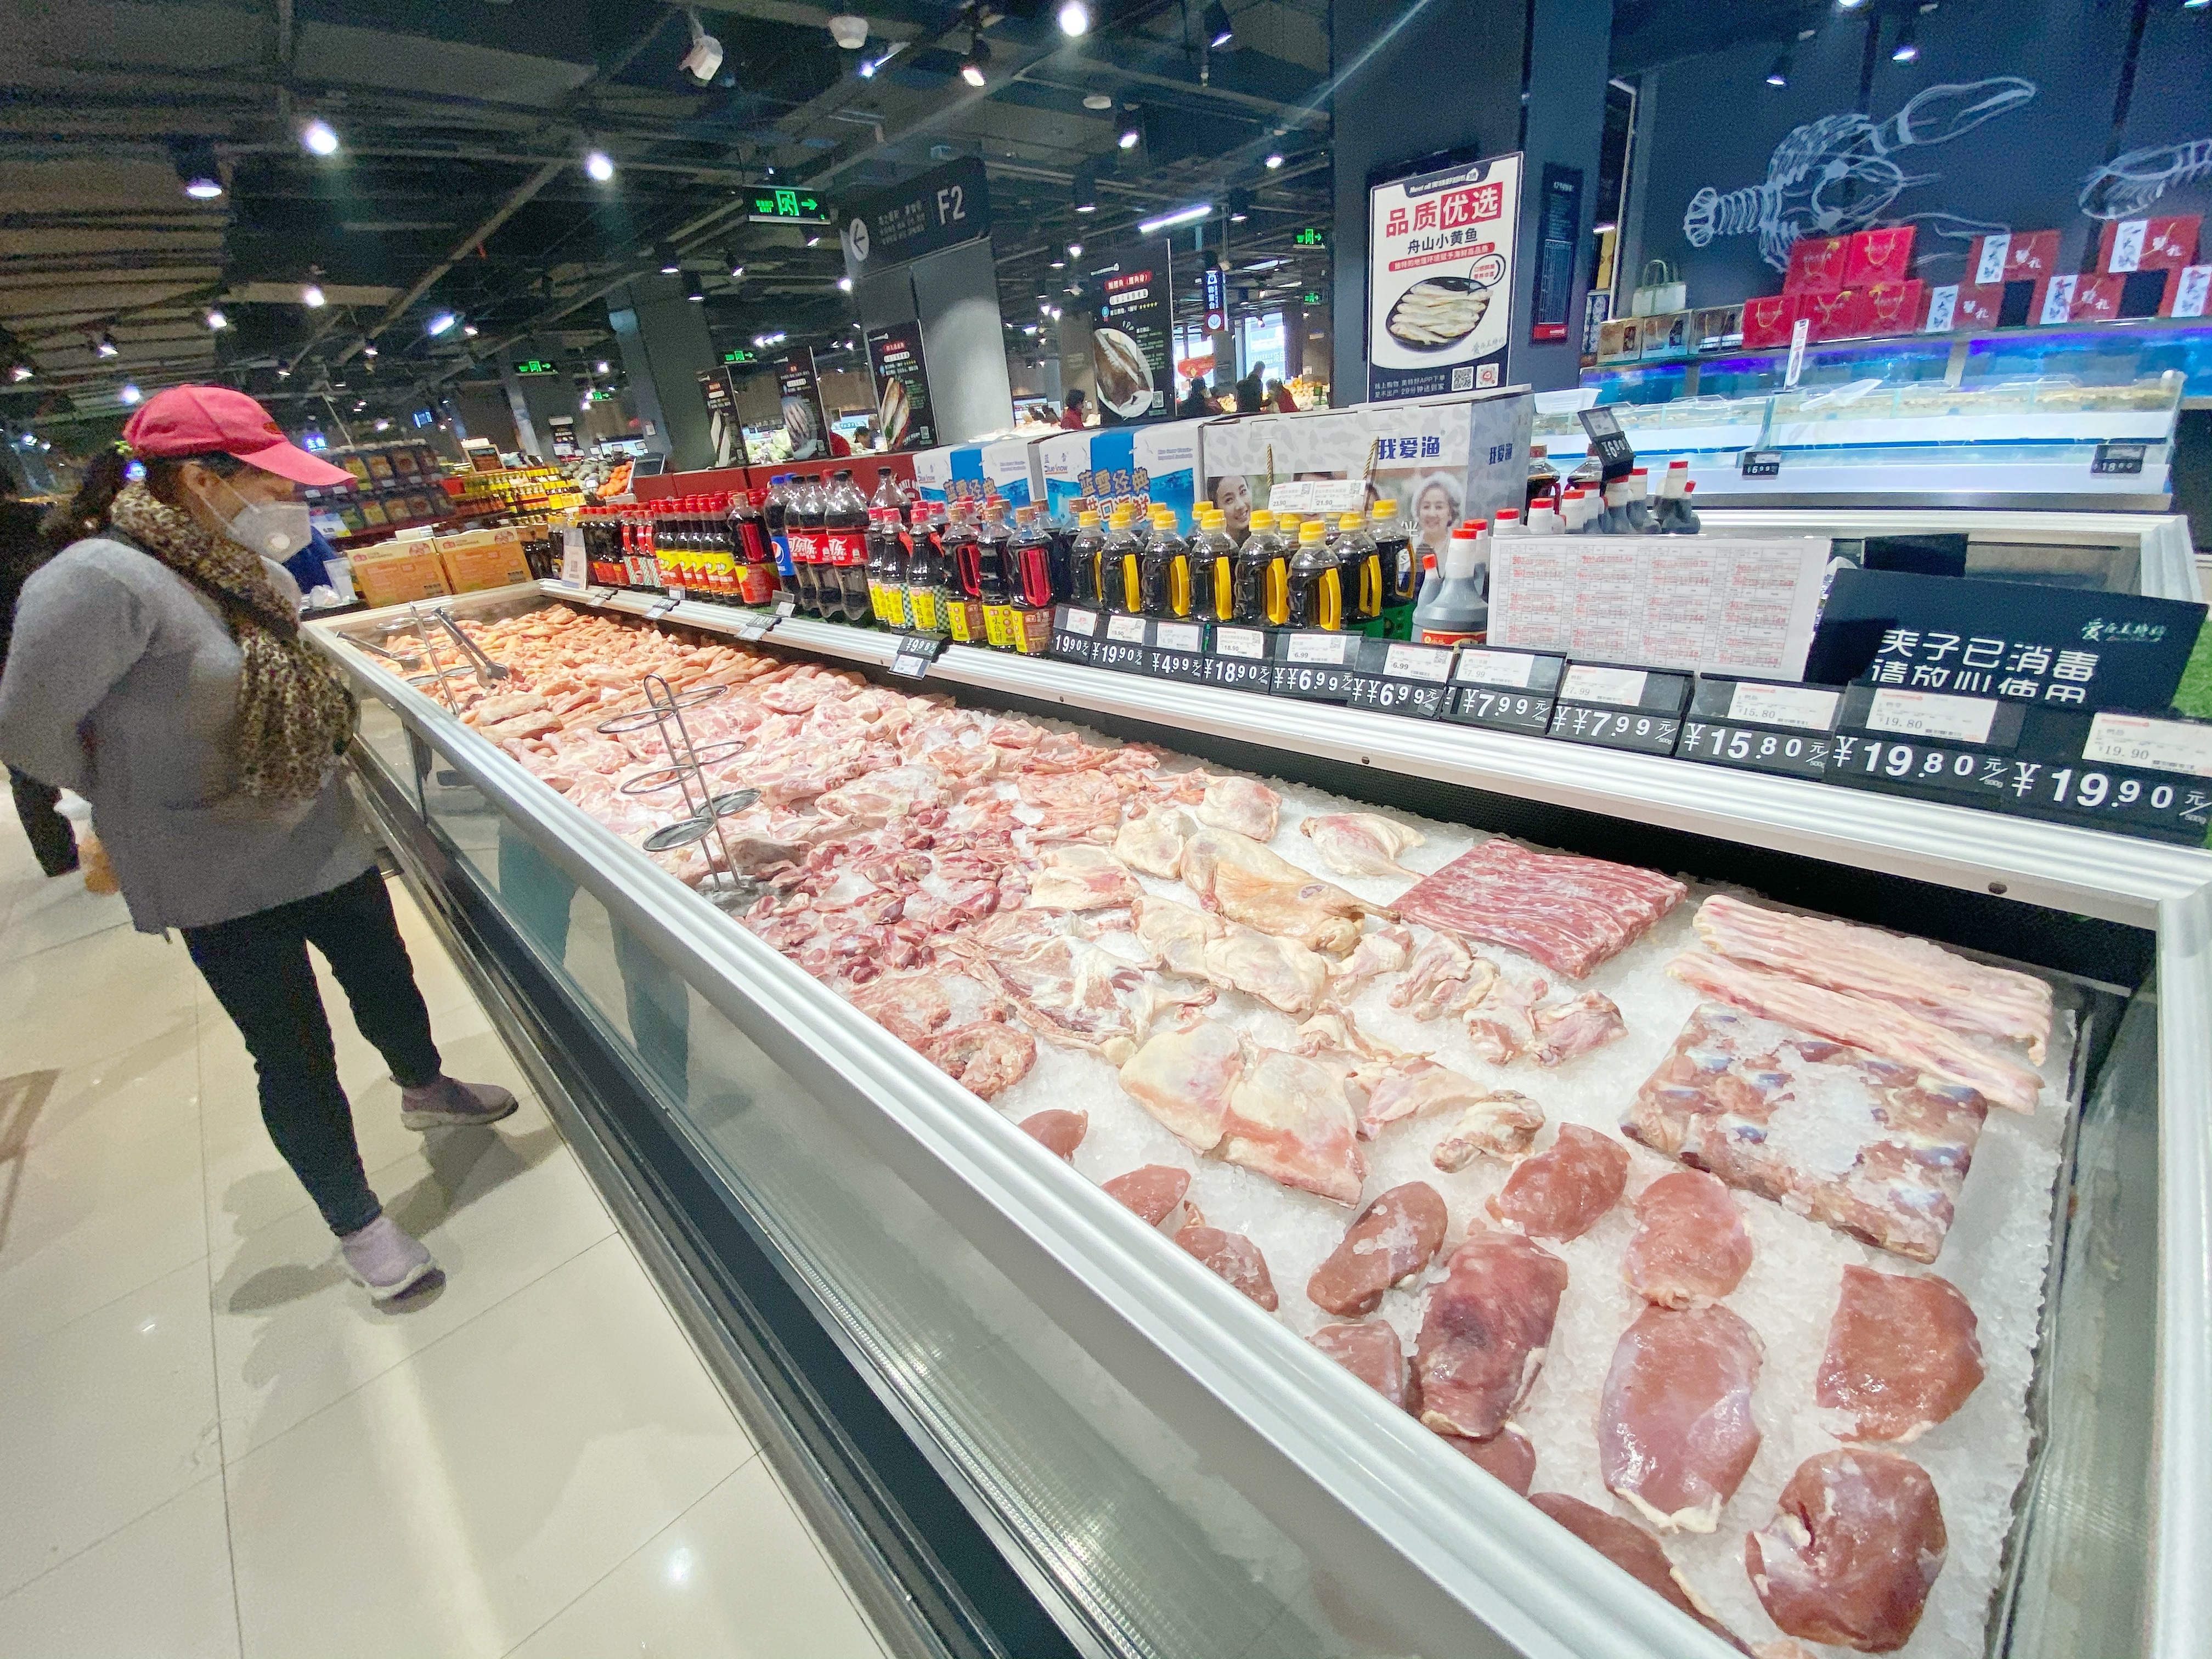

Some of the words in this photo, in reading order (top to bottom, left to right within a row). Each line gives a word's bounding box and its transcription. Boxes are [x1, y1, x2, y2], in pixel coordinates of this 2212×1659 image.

[938, 185, 966, 225] F2
[1386, 187, 1498, 238] 品质优选
[1408, 228, 1477, 255] 舟山小黄鱼
[1378, 436, 1440, 460] 我爱渔
[1489, 443, 1513, 465] 我爱渔
[1078, 467, 1150, 496] 蓝雪经典
[905, 637, 931, 652] ¥9.98
[1056, 634, 1082, 653] 19.90
[1092, 642, 1135, 663] ¥19.90
[1878, 628, 2100, 682] 夹子已消毒
[1152, 652, 1189, 674] ¥4.99
[1204, 658, 1257, 682] ¥18.90
[1463, 689, 1528, 718] ¥7.99
[1684, 723, 1804, 759] ¥15.80
[1832, 735, 1974, 778] ¥19.80
[2012, 761, 2174, 809] ¥19.90
